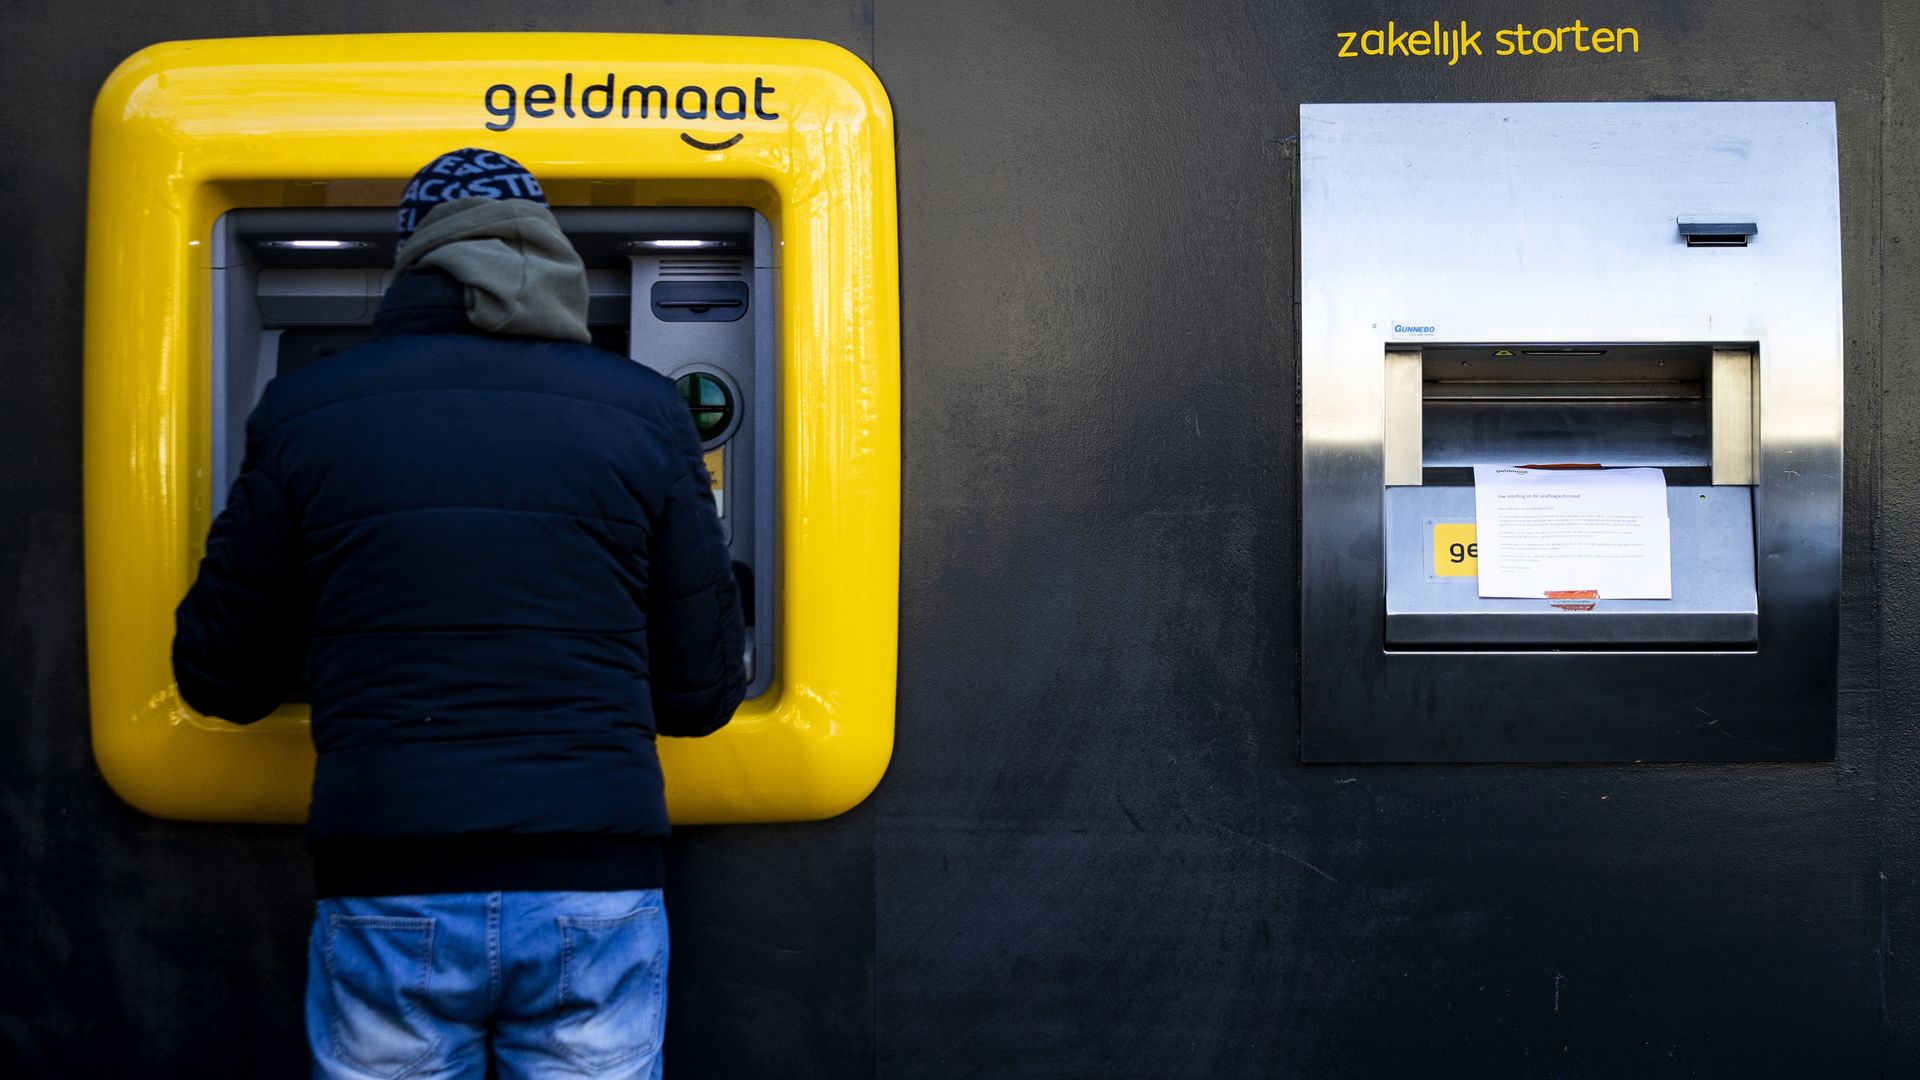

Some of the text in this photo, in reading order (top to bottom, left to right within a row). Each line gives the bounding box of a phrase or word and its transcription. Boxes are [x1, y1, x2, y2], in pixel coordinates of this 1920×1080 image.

[1338, 19, 1639, 65] zakelijk storten
[485, 73, 779, 132] geldmaat
